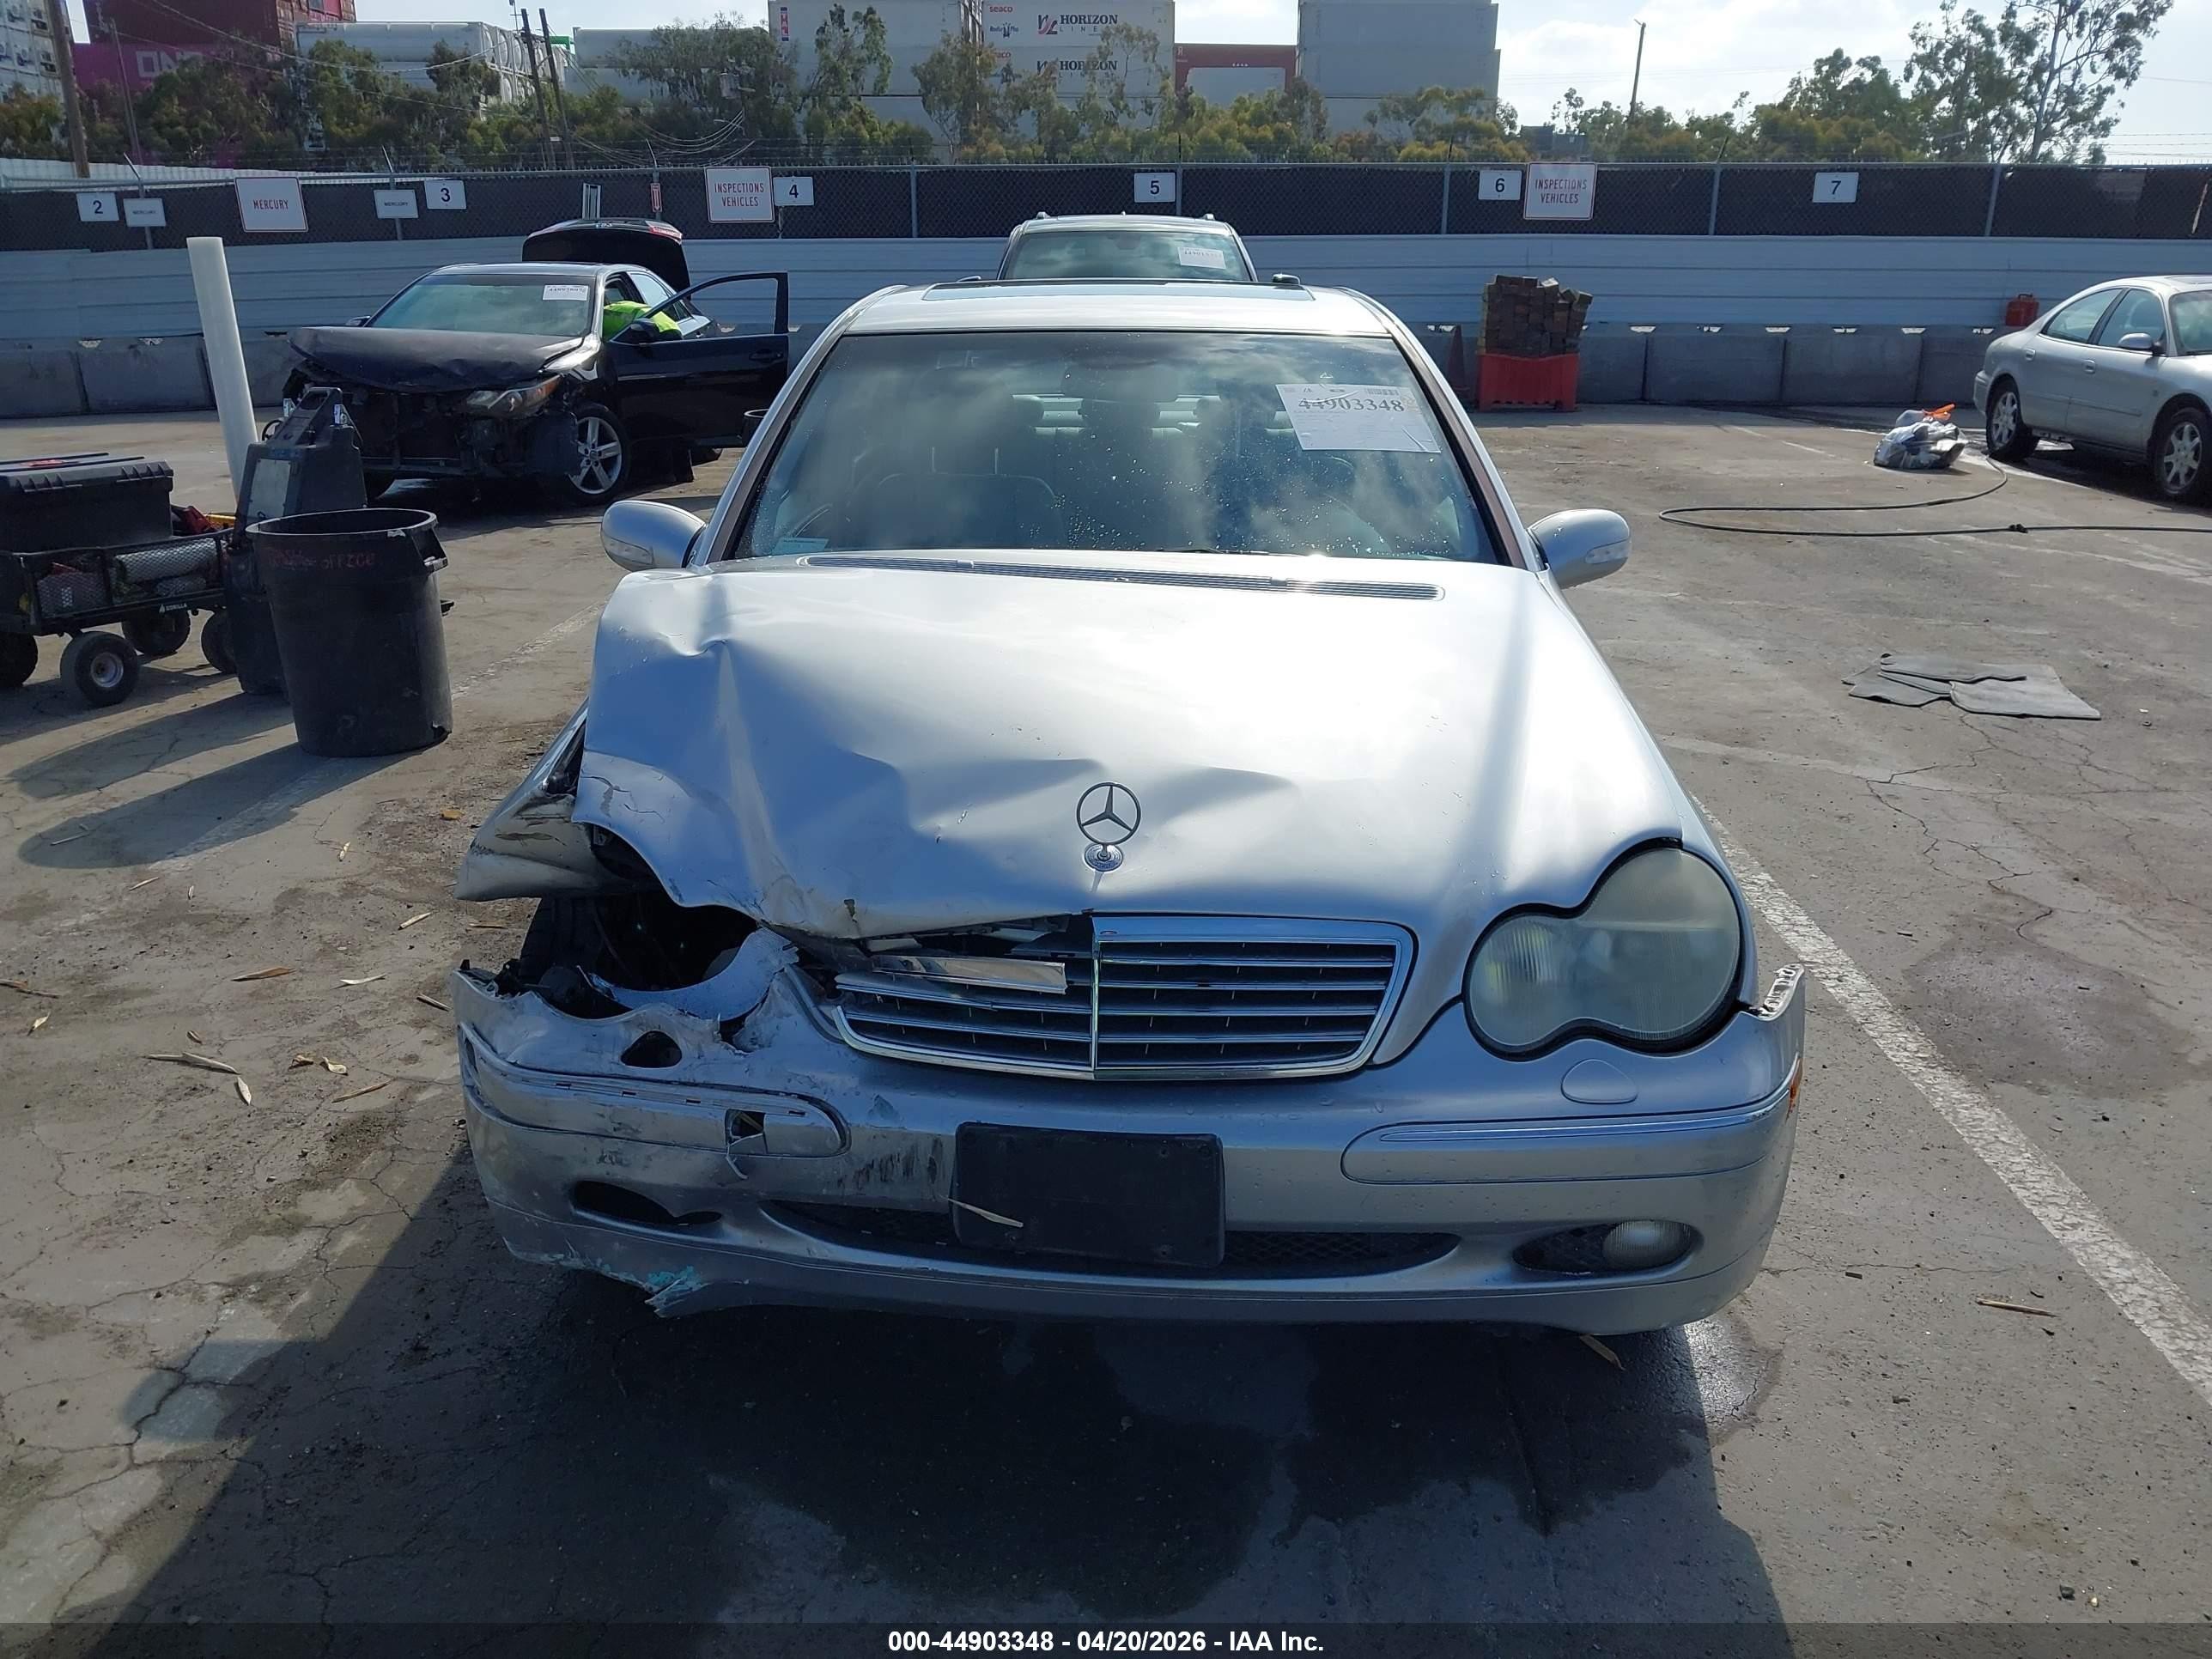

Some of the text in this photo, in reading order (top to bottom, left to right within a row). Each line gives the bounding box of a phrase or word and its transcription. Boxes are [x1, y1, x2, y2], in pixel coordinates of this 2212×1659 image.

[1060, 14, 1118, 25] HORIZON
[714, 182, 765, 193] INSPECTIONS
[788, 184, 799, 198] 4
[1150, 179, 1161, 195] 5
[1494, 177, 1505, 192] 6
[1534, 179, 1588, 190] INSPECTIONS
[1831, 180, 1842, 195] 7
[440, 187, 452, 203] 3
[721, 196, 759, 207] VEHICLES
[1540, 192, 1580, 204] VEHICLES
[93, 199, 104, 215] 2
[252, 198, 289, 210] MERCURY
[1298, 398, 1405, 412] 44903348
